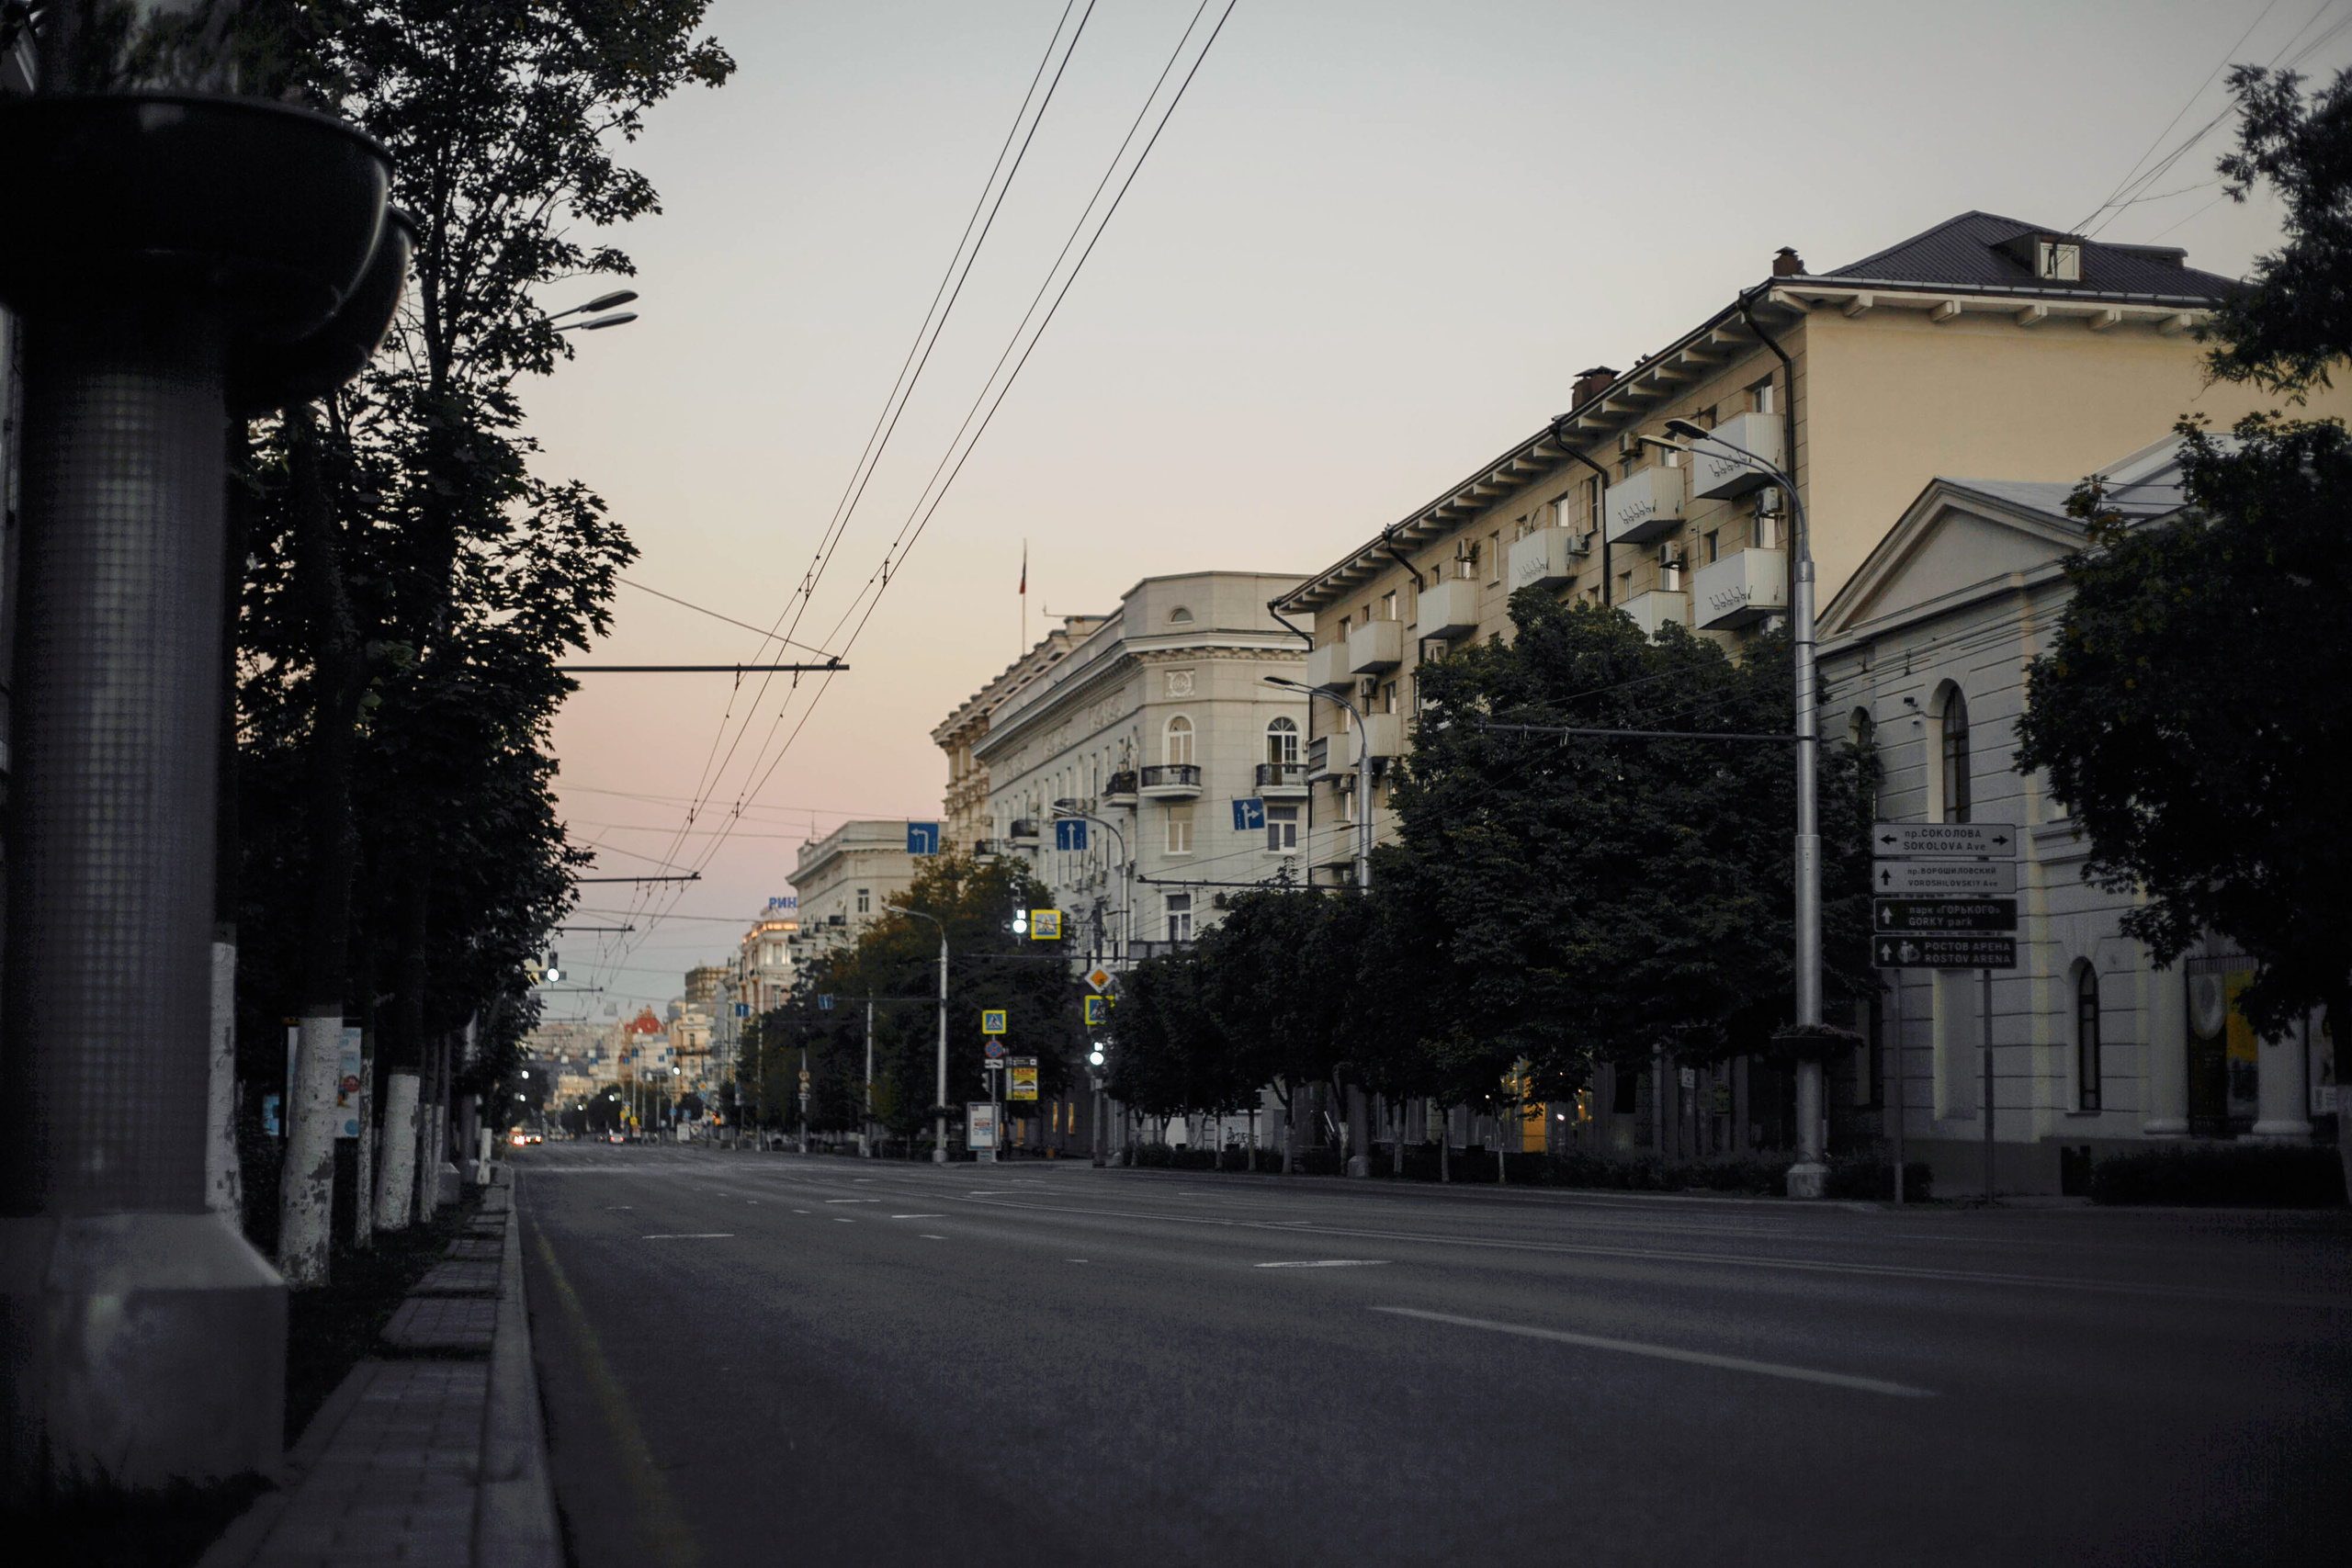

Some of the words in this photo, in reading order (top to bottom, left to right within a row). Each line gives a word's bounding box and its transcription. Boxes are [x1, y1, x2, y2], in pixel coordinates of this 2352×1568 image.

[1904, 841, 1962, 851] SOKOLOVA
[1908, 907, 1933, 916] парк
[1908, 918, 1943, 927] GORKY
[1947, 918, 1973, 928] park
[1925, 942, 1969, 952] РОСТОВ
[1972, 942, 2010, 952] АРЕНА
[1925, 953, 1969, 964] ROSTOV
[1972, 953, 2010, 964] ARENA
